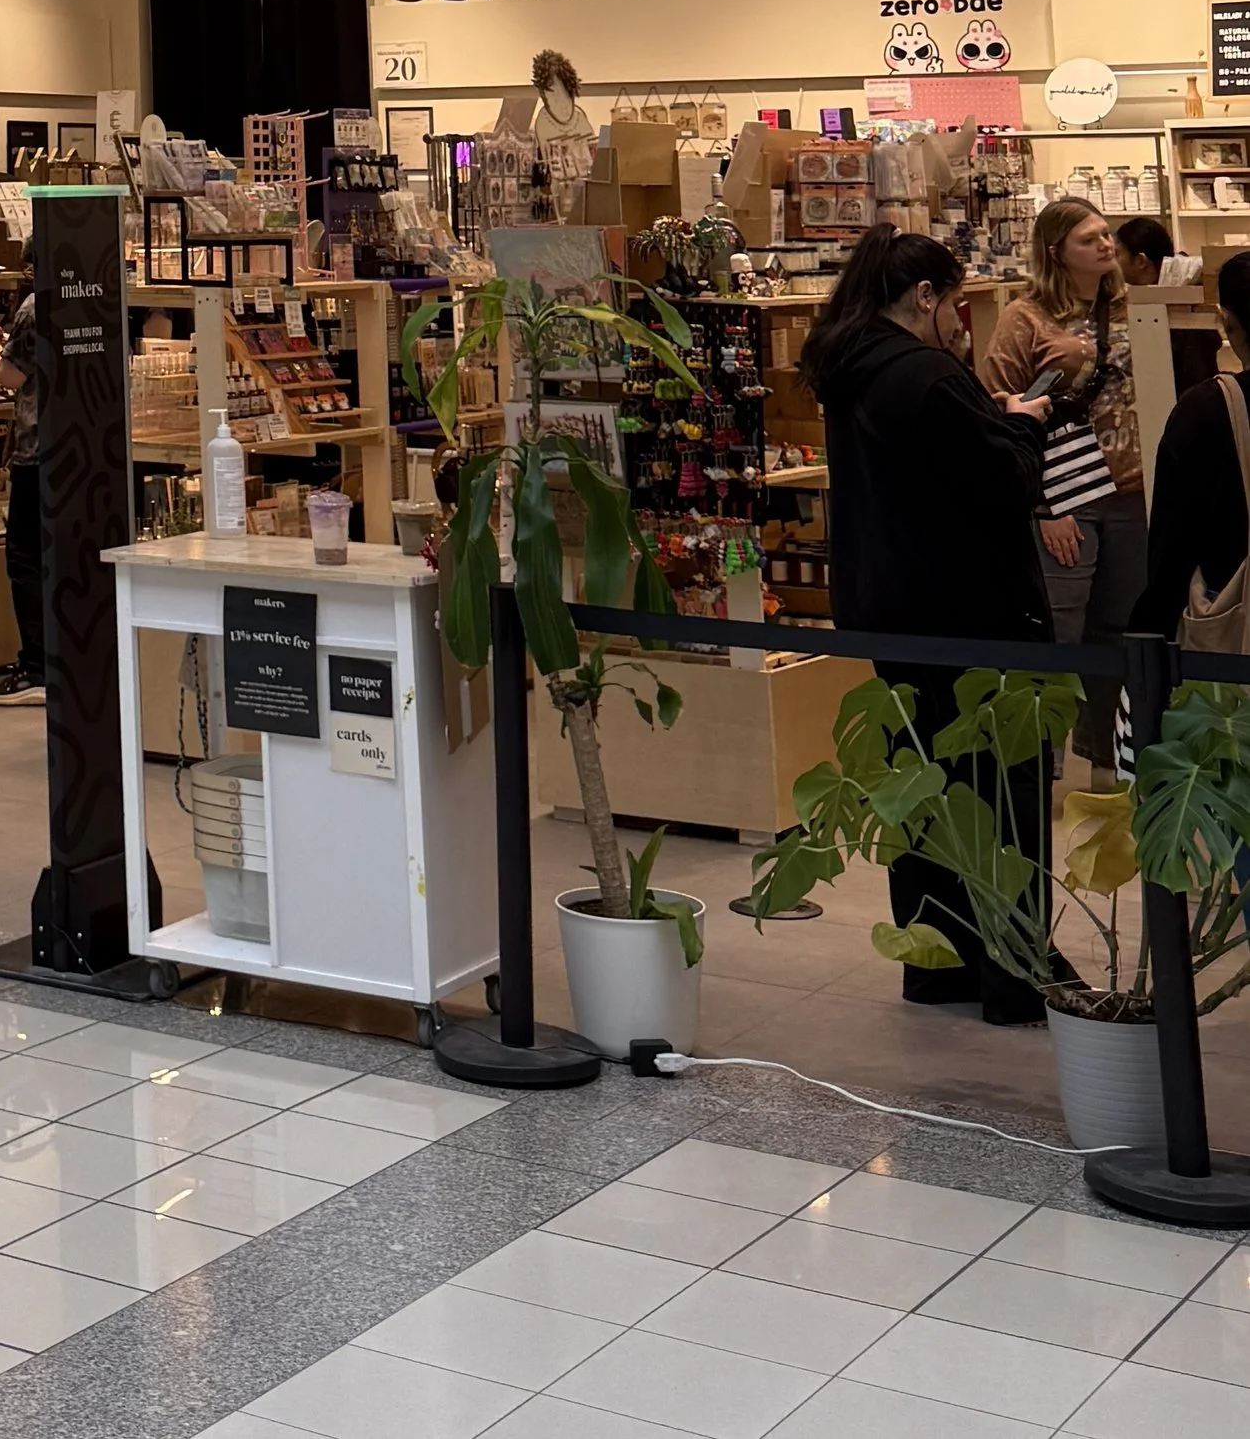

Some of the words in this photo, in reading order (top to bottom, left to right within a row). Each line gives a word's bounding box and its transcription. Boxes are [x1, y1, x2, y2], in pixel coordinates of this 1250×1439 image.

[880, 0, 939, 17] zero
[385, 57, 416, 81] 20
[61, 280, 103, 298] makers
[63, 328, 81, 338] THANK
[82, 327, 91, 337] YOU
[92, 326, 102, 336] FOR
[63, 343, 88, 355] SHOPPING
[89, 342, 105, 353] LOCAL
[254, 597, 286, 609] makers
[252, 631, 291, 646] service
[293, 635, 310, 650] fee
[258, 665, 283, 679] why?
[341, 675, 353, 685] no
[354, 676, 382, 688] paper
[342, 686, 381, 701] receipts
[336, 729, 372, 743] cards
[361, 747, 386, 763] only
